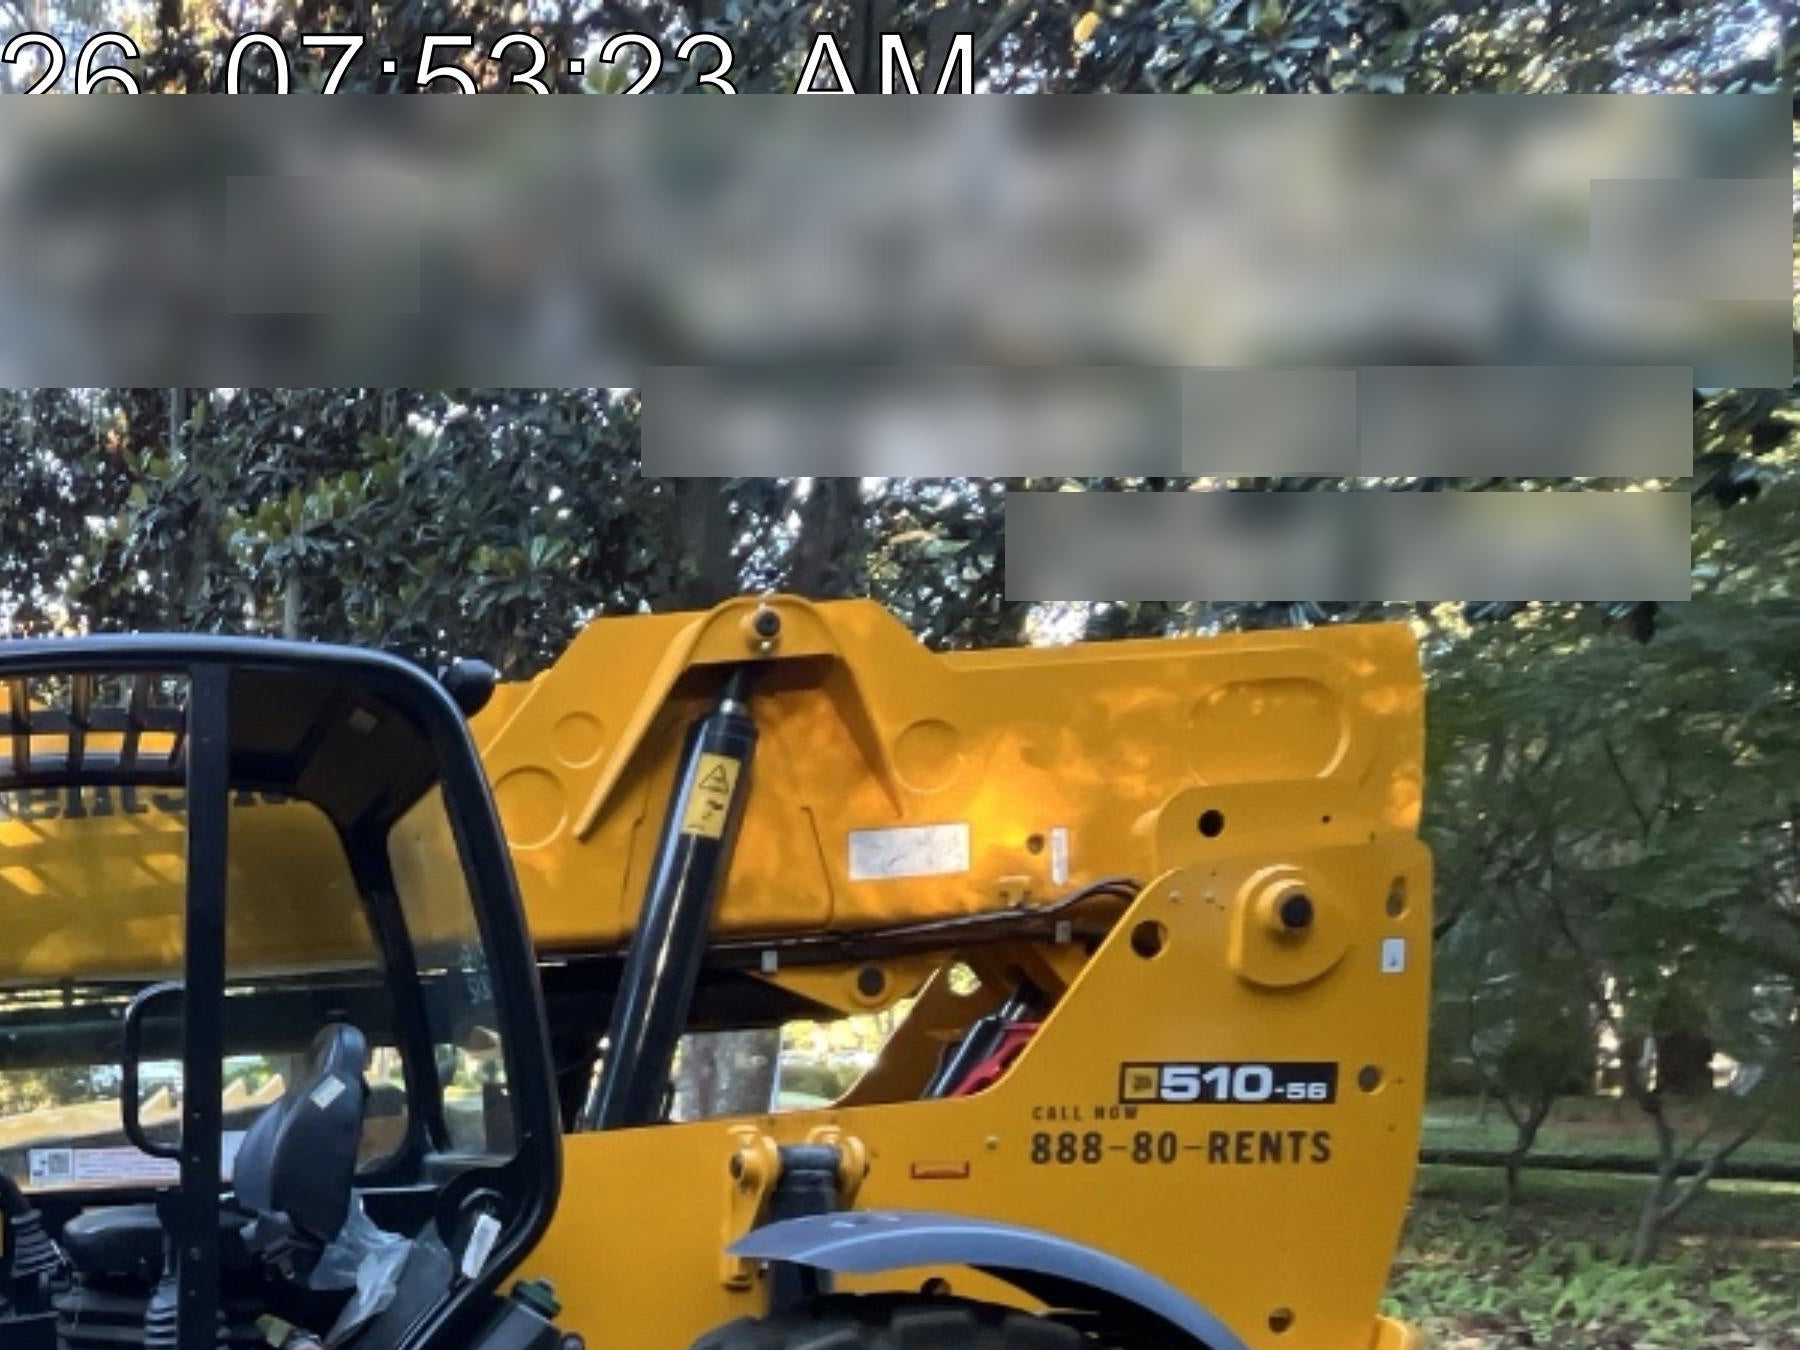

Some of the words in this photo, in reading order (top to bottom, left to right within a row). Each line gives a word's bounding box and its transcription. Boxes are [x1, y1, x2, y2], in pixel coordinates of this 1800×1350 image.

[1160, 1065, 1327, 1101] 510-56
[1032, 1106, 1082, 1120] CALL
[1094, 1105, 1138, 1120] NOW
[1030, 1131, 1332, 1165] 888-80-RENTS
